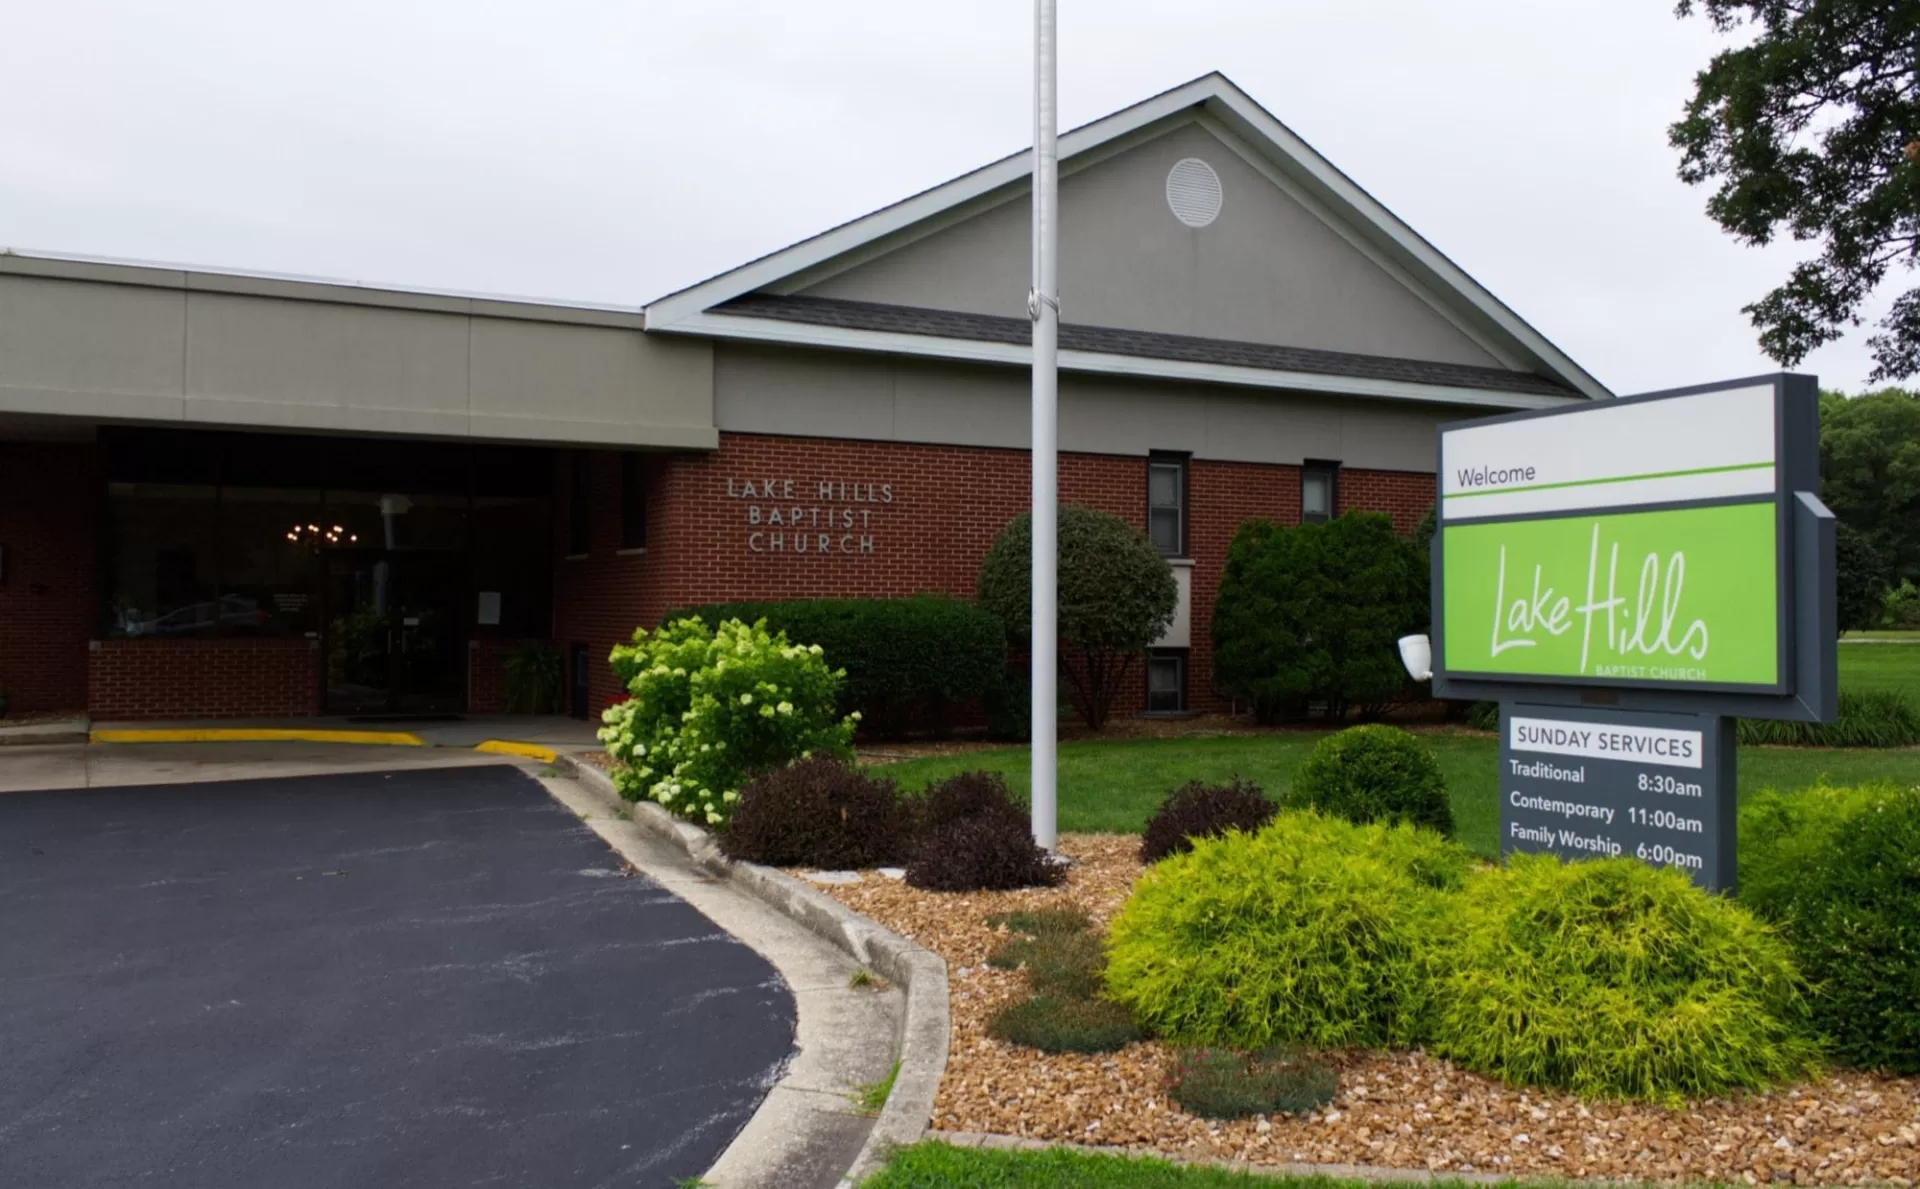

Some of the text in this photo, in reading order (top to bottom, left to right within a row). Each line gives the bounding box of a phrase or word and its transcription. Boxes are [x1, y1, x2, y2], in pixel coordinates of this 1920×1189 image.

[728, 477, 893, 503] LAKE HILLS
[1457, 464, 1536, 488] Welcome
[749, 505, 872, 528] BAPTIST
[749, 532, 873, 553] CHURCH
[1491, 522, 1709, 675] Lake Hills
[1595, 664, 1706, 680] BAPTIST CHURCH
[1517, 726, 1693, 758] SUNDAY SERVICES
[1510, 760, 1702, 797] Traditional 8:30am
[1510, 791, 1702, 832] Contemporary 11:00am
[1510, 822, 1702, 869] Family Worship 6:00pm
